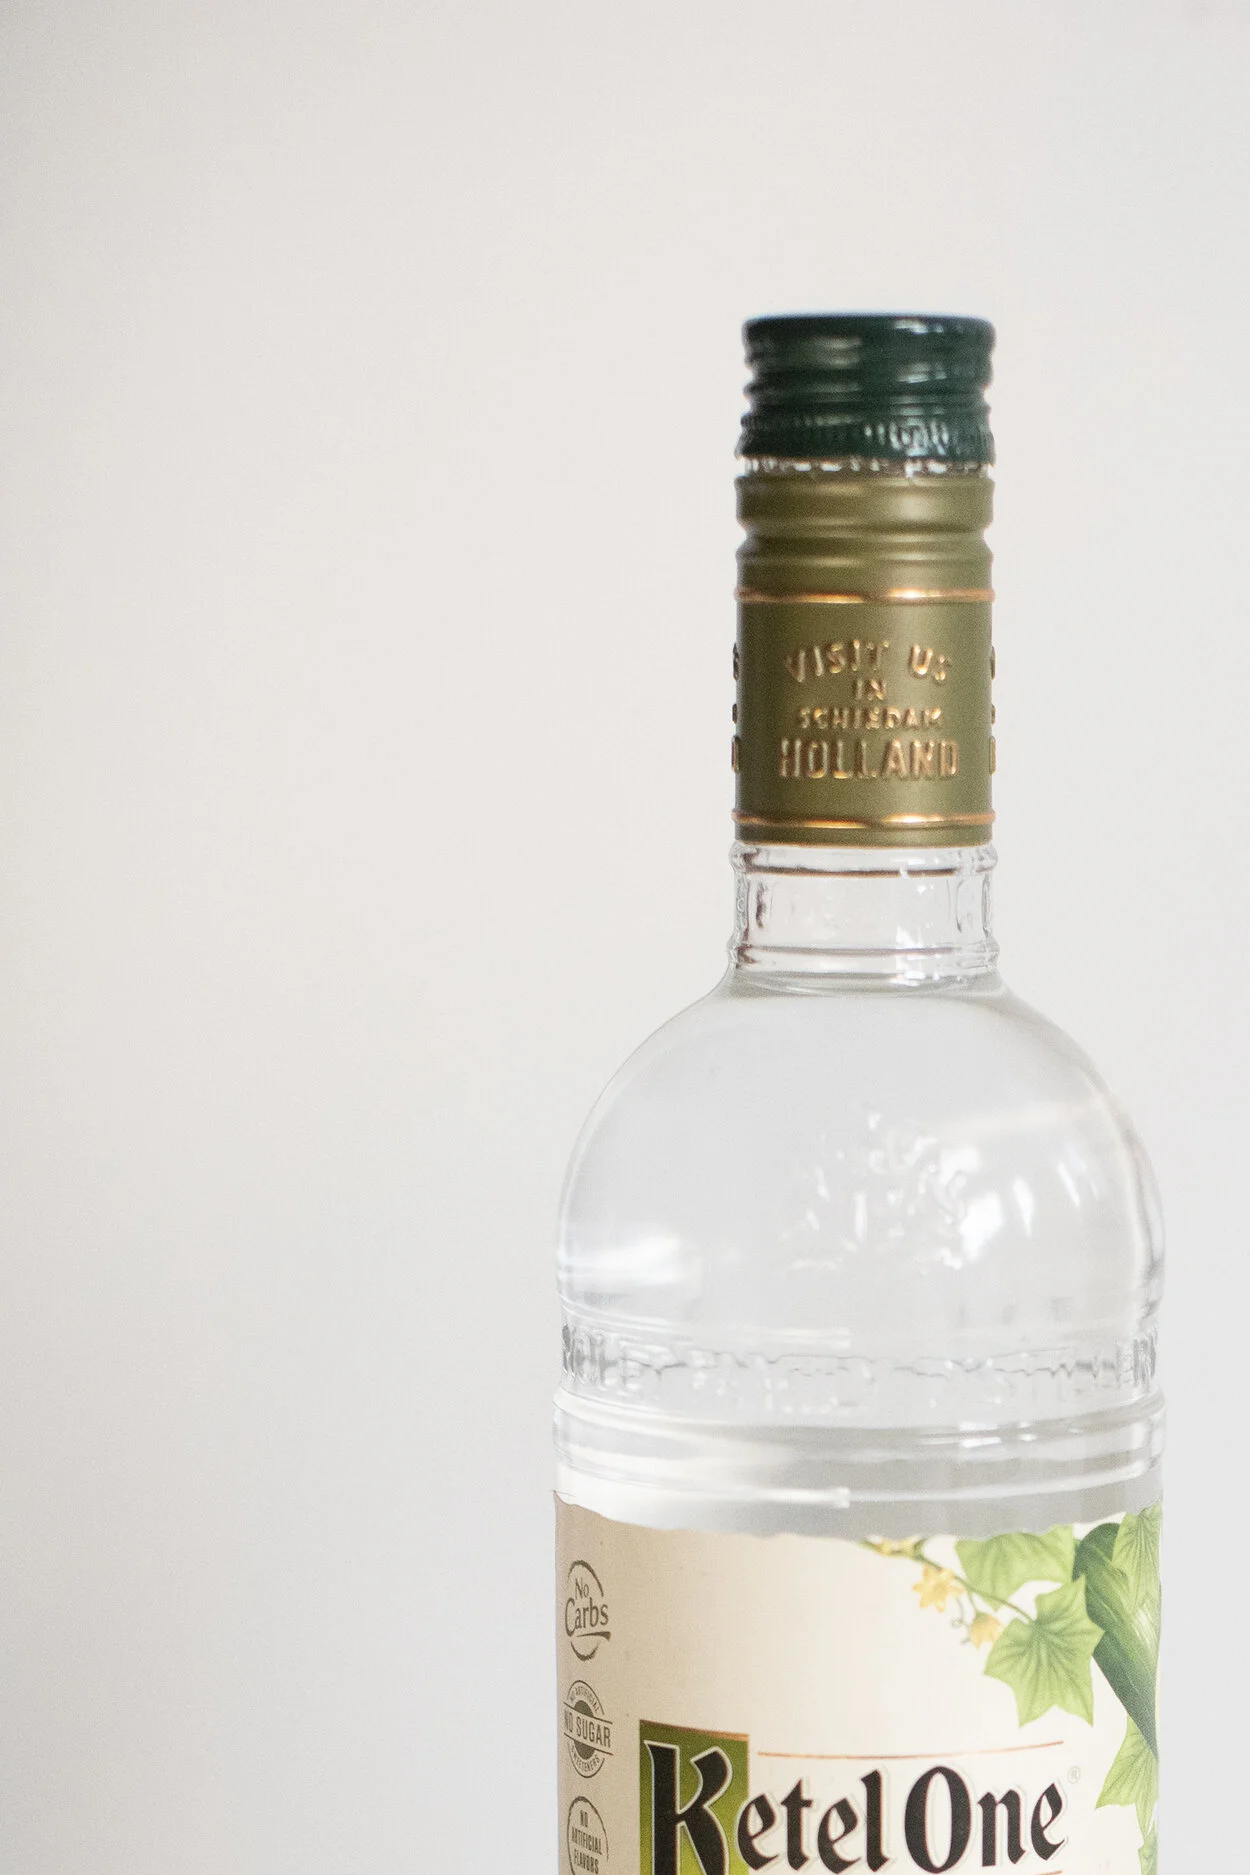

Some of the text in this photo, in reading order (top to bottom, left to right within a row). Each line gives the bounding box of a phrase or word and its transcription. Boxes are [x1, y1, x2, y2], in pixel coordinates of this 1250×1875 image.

[785, 639, 951, 682] VISIT US
[855, 679, 887, 701] IN
[779, 737, 960, 779] HOLLAND
[575, 1577, 589, 1599] No
[564, 1596, 609, 1637] Carbs
[564, 1708, 611, 1748] NO SUGAR
[903, 1765, 1066, 1874] One
